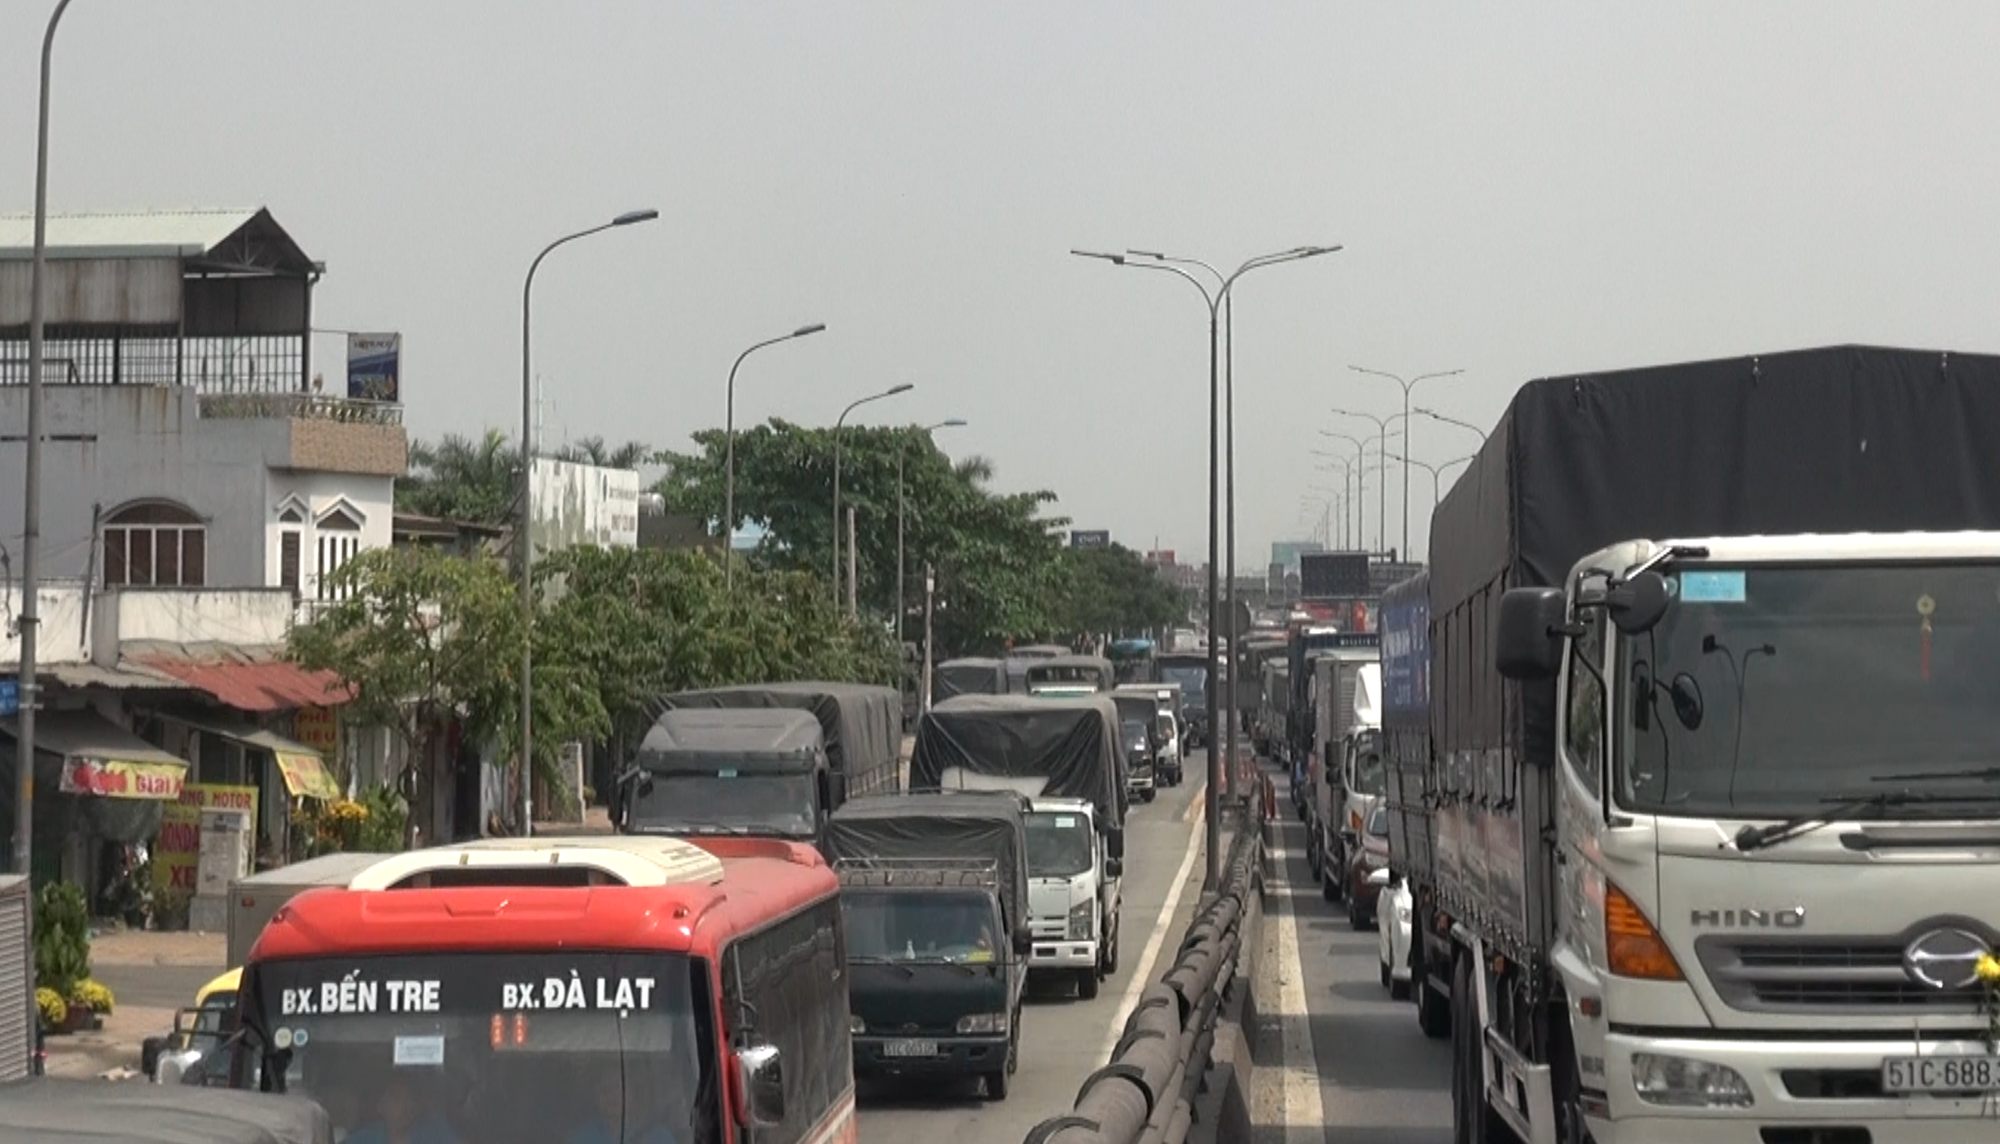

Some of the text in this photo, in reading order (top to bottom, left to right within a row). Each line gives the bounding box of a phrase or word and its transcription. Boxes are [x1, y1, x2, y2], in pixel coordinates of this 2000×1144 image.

[212, 791, 251, 810] MOTOR
[1691, 908, 1805, 928] HINO
[385, 979, 441, 1012] TRE
[596, 977, 655, 1019] LẠT
